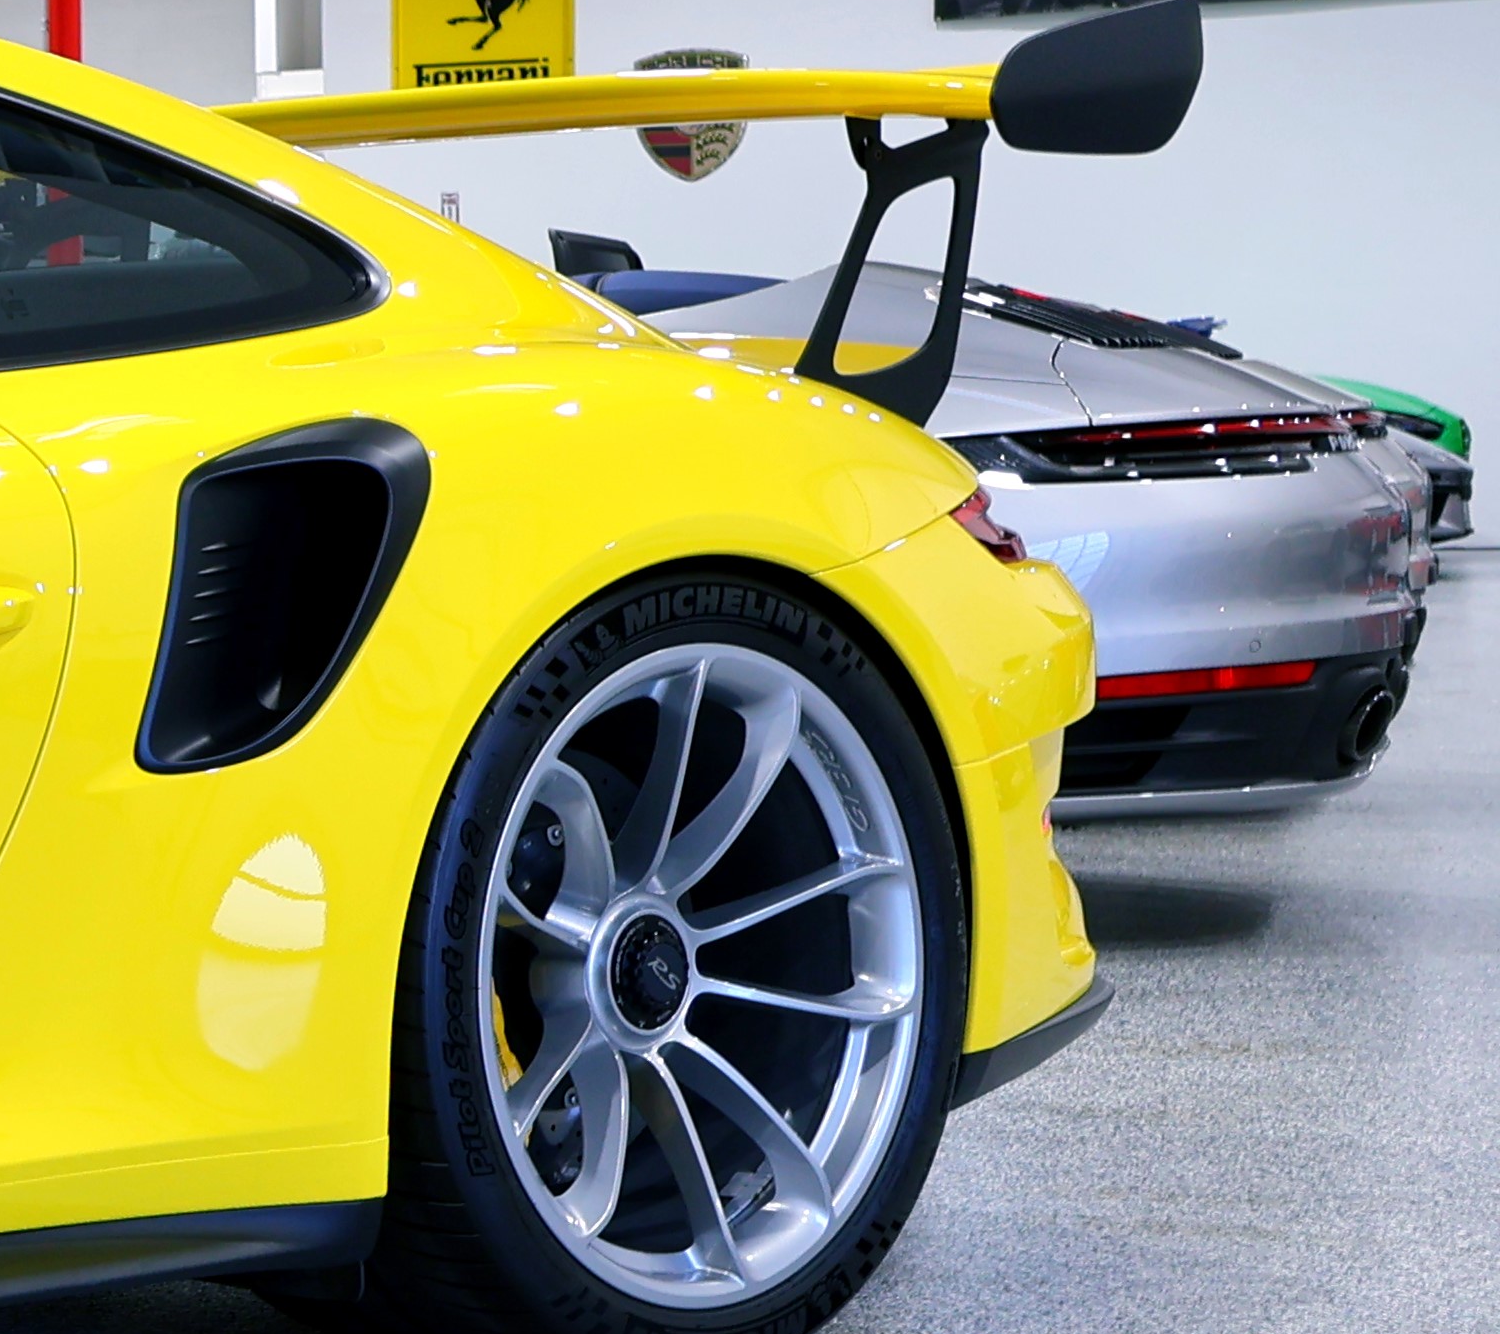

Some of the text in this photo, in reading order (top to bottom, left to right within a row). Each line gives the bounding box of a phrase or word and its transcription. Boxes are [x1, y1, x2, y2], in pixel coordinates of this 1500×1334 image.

[622, 585, 806, 638] MICHELIN
[441, 817, 496, 1178] Pilot Sport Cup 2
[647, 955, 681, 991] RS
